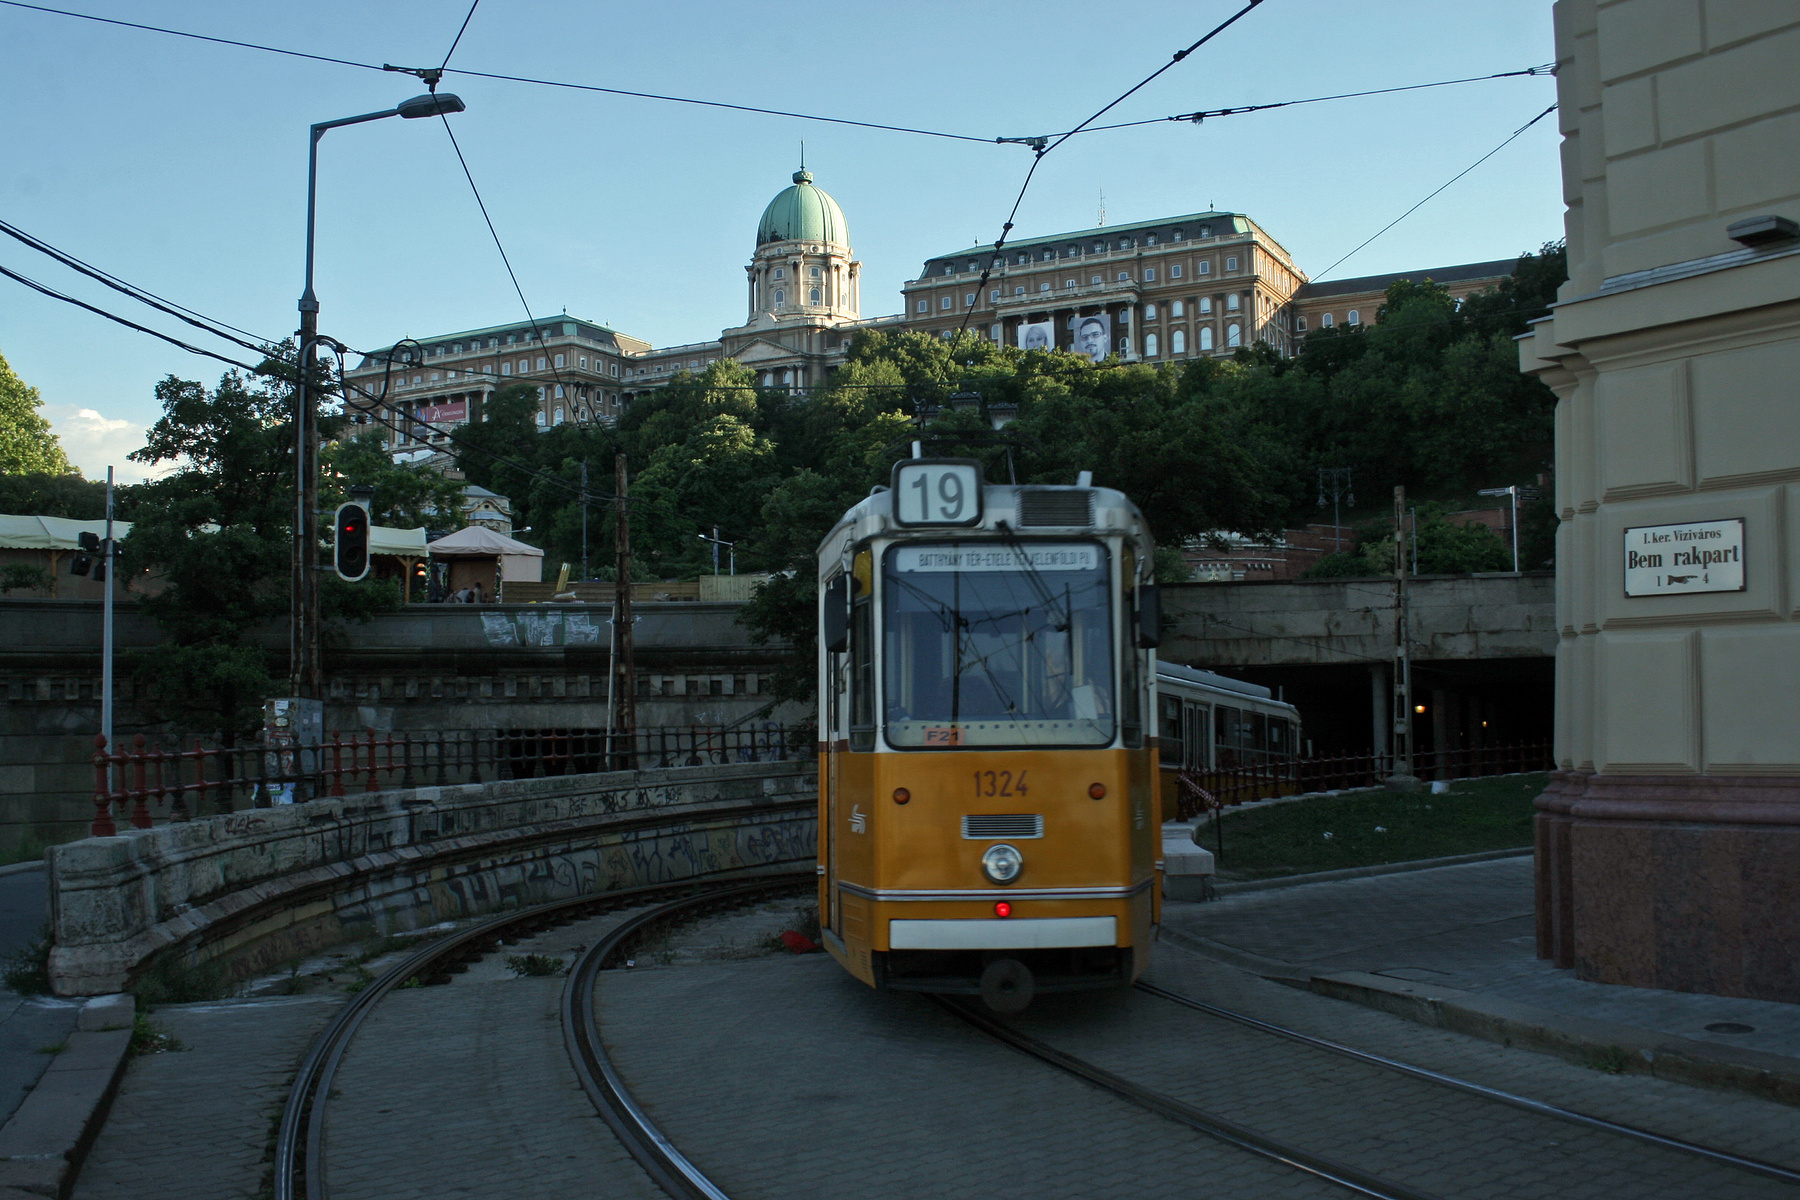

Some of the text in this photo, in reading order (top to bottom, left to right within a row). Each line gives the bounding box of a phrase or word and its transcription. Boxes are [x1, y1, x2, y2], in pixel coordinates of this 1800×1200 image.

[911, 472, 964, 520] 19
[1643, 532, 1651, 544] I.
[1652, 532, 1671, 544] ker.
[1628, 545, 1739, 569] Bem rakpart
[1656, 573, 1709, 587] 1 4
[927, 730, 959, 742] F21
[974, 769, 1029, 798] 1324
